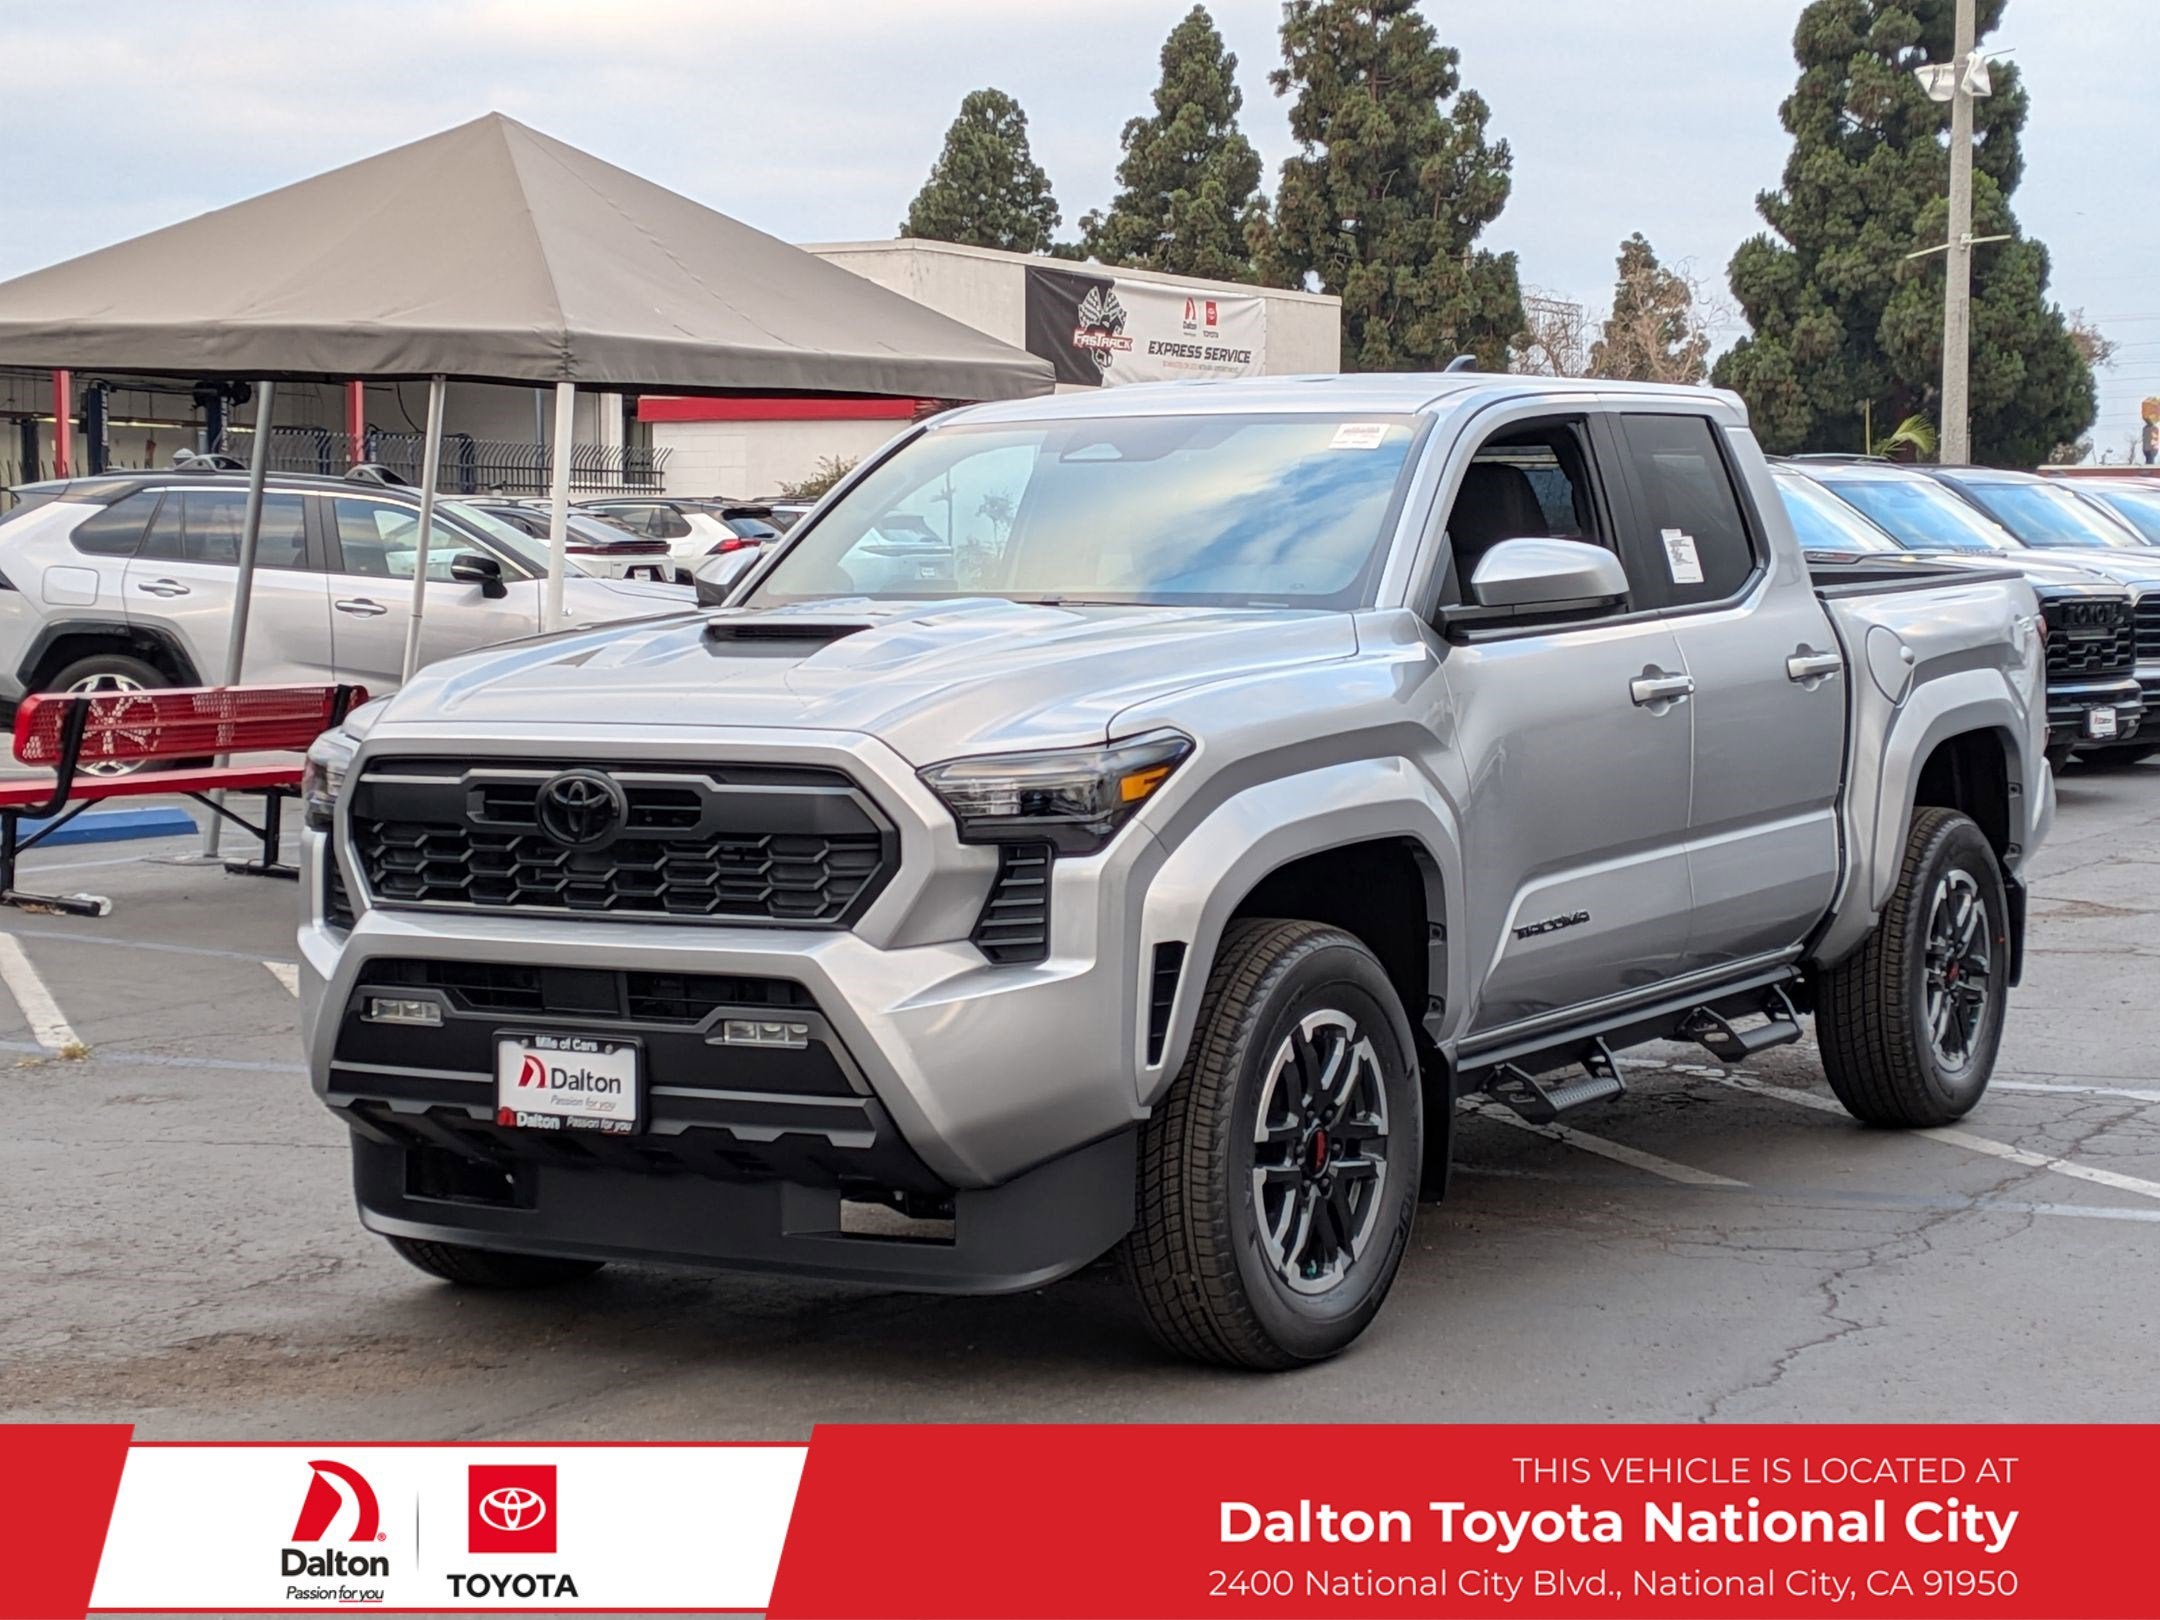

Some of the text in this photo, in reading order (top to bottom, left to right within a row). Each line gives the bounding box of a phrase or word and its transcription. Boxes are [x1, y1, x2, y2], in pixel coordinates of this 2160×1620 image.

[1148, 340, 1252, 364] EXPRESS SERVICE
[1512, 911, 1591, 940] TACOMA
[560, 1038, 571, 1050] of
[572, 1038, 598, 1052] Cars
[551, 1067, 621, 1094] Dalton
[551, 1094, 617, 1111] Passion for you
[516, 1111, 633, 1133] Dalton Passion for you
